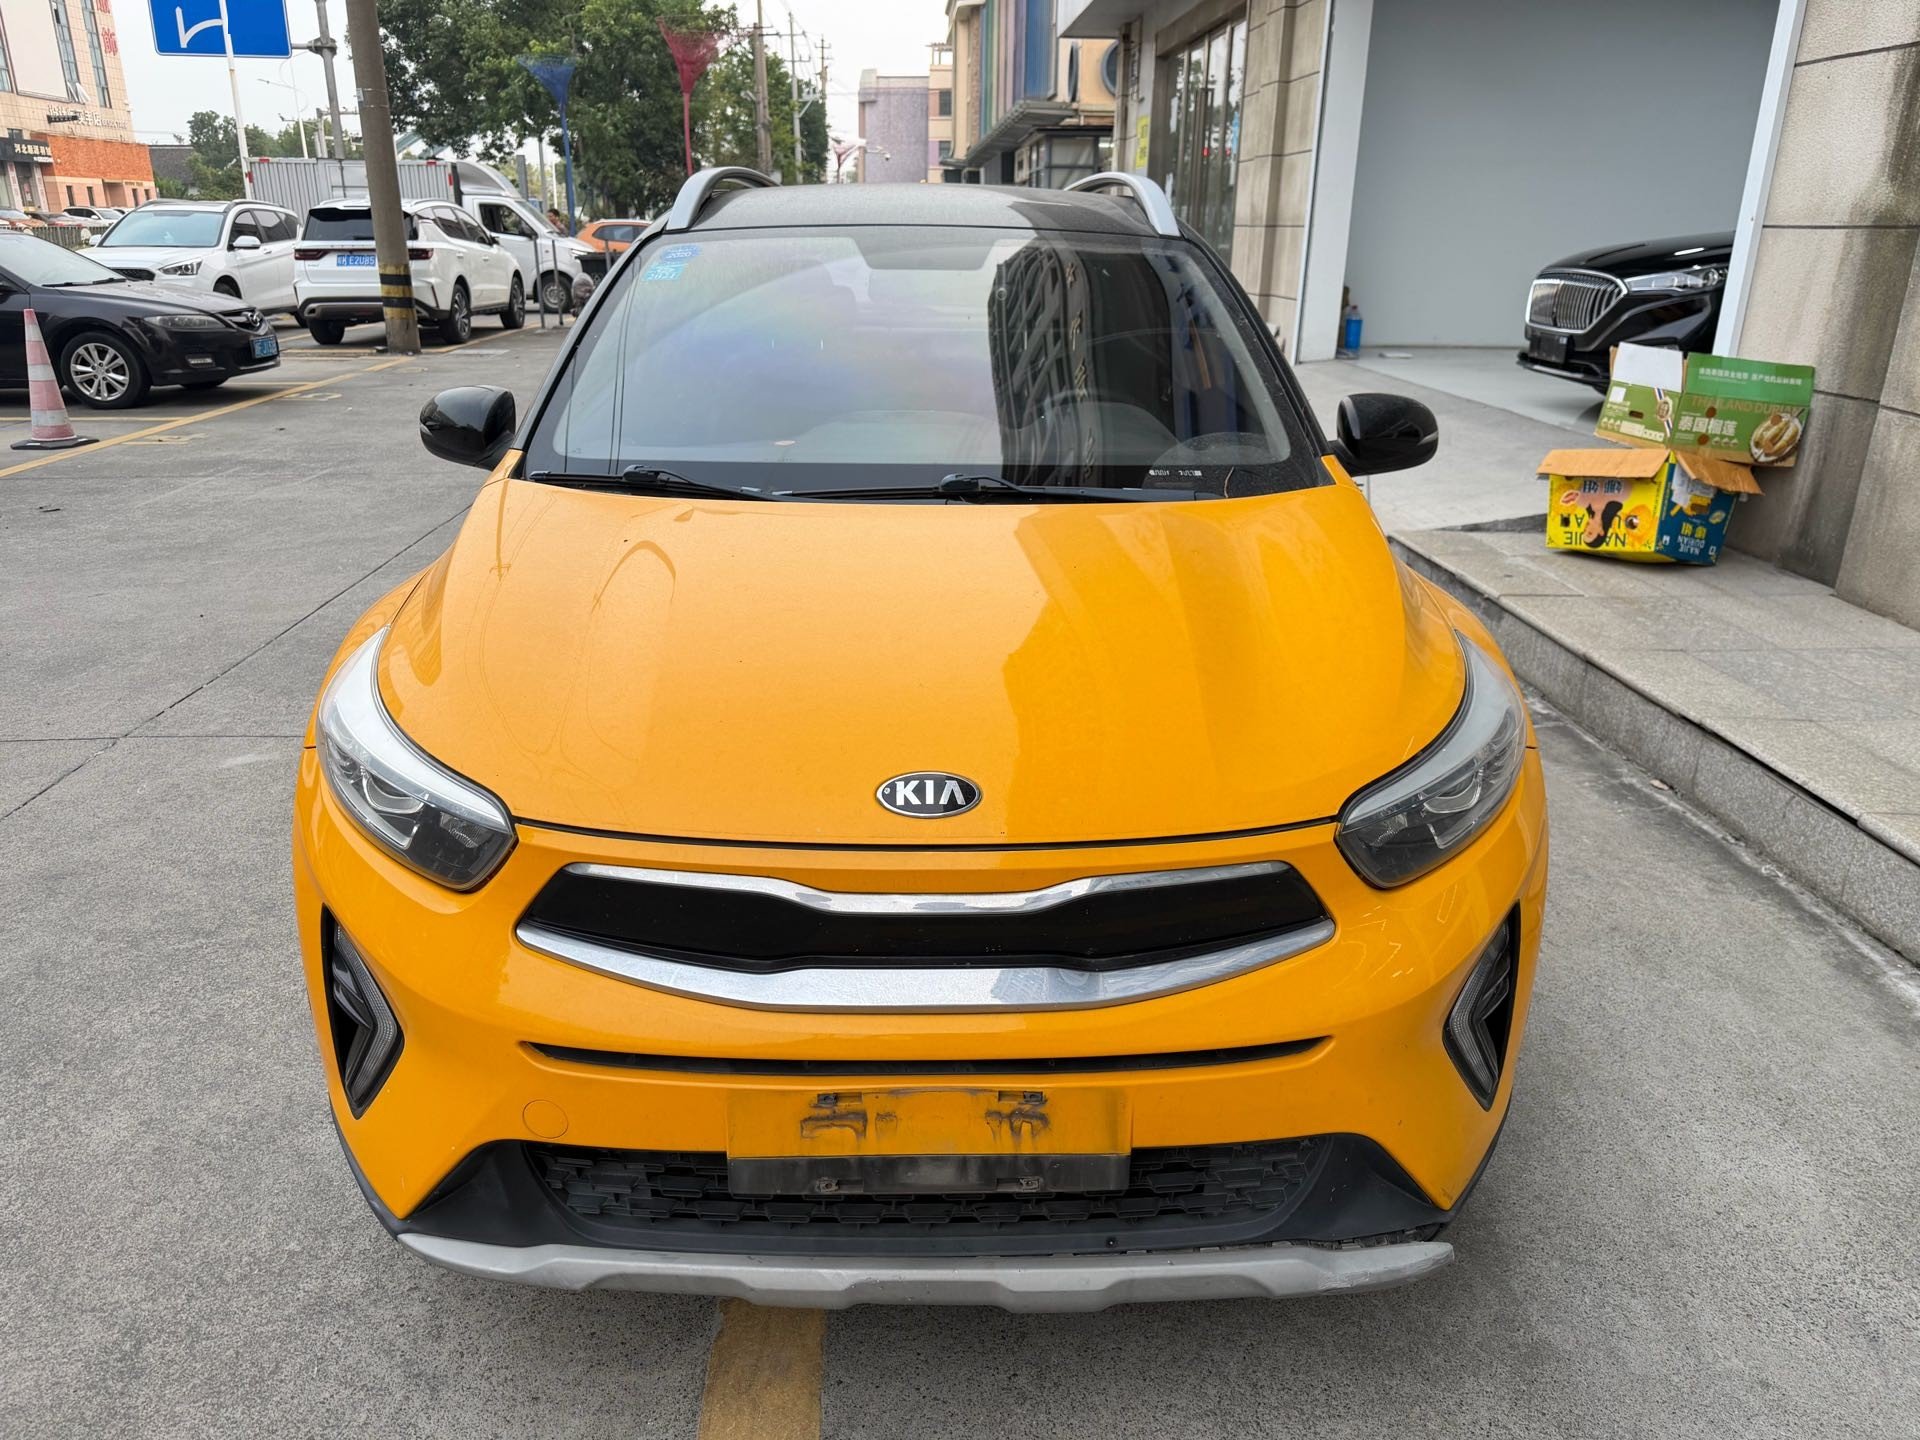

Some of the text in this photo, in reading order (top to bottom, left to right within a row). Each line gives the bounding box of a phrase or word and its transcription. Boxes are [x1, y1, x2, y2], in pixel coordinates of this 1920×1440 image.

[1678, 415, 1738, 437] 泰国榴莲
[1677, 535, 1705, 549] DURIAN
[1678, 544, 1701, 556] NAJIE
[895, 779, 966, 806] KIA
